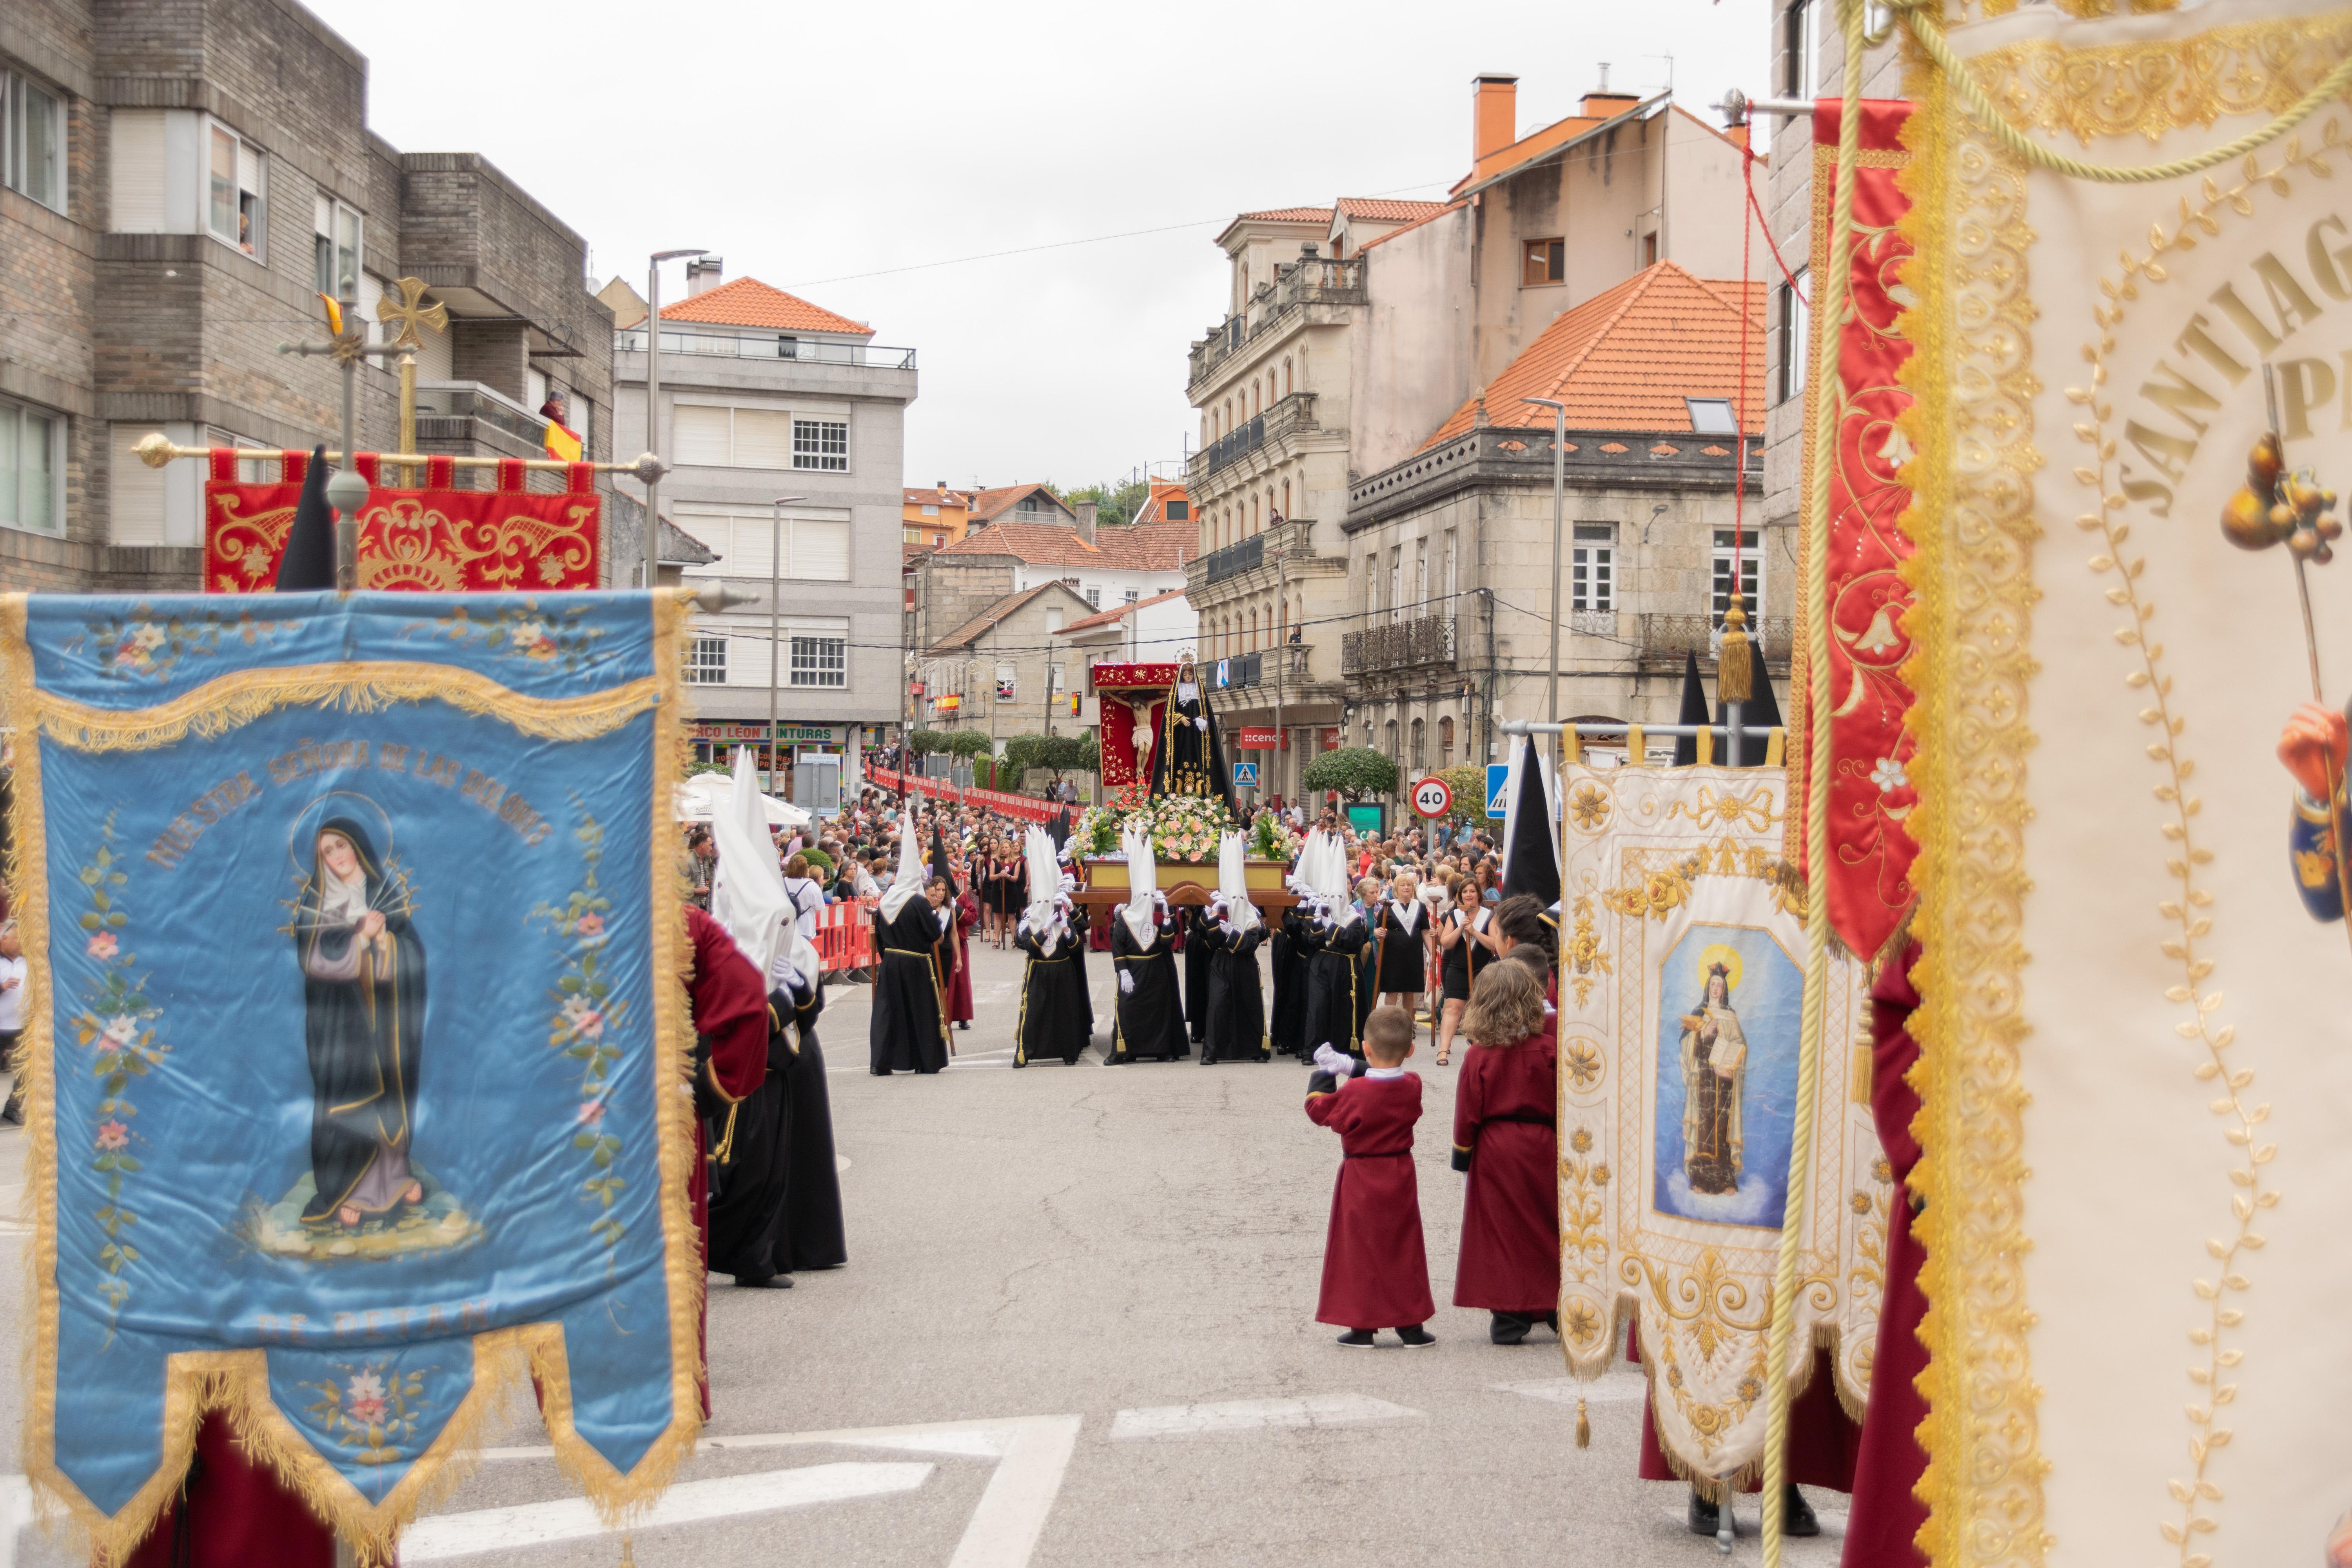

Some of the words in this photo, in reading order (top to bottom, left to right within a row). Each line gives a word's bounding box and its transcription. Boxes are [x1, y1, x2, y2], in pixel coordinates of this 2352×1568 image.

[2276, 348, 2352, 443] P
[727, 727, 760, 738] LEON
[146, 770, 263, 870] NUESTRA
[268, 737, 371, 786] SEÑORA
[380, 742, 410, 773] DE
[460, 768, 553, 848] DOLORES
[1419, 792, 1443, 805] 40
[258, 1313, 308, 1345] DE
[334, 1298, 489, 1341] PETAN
